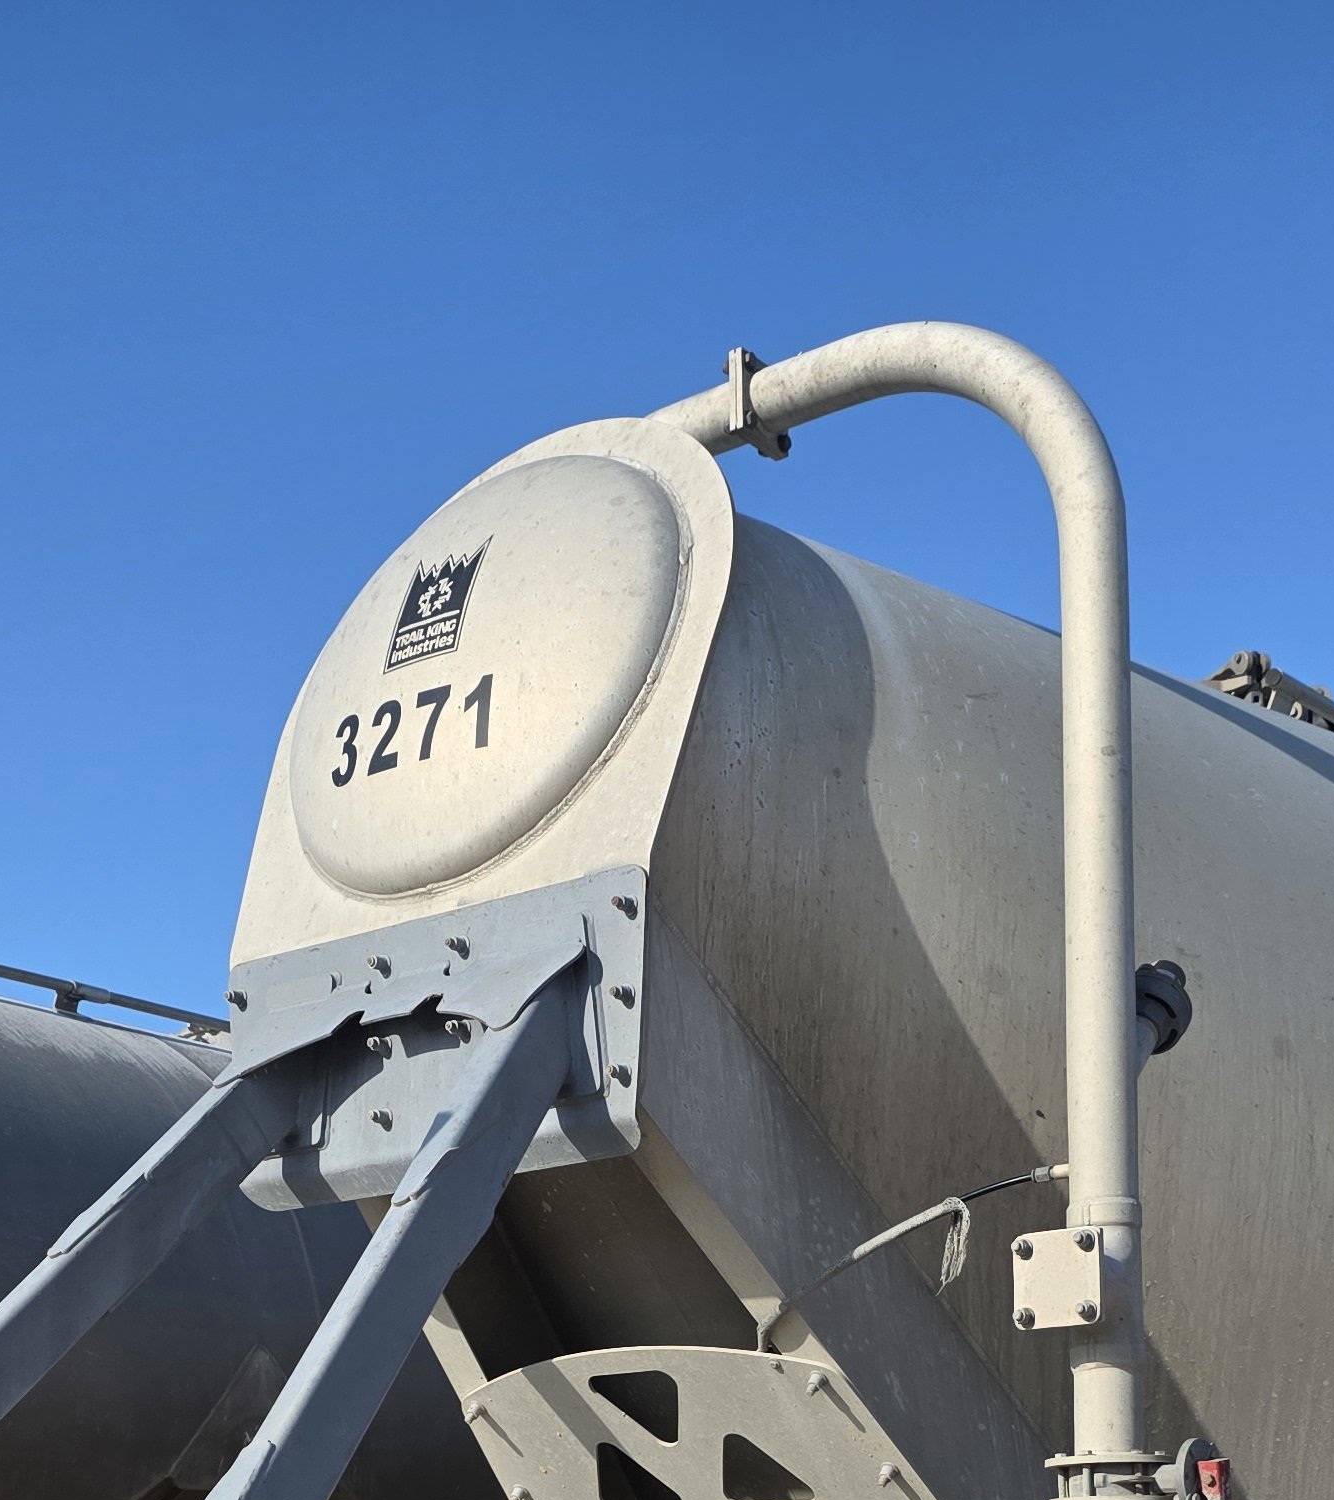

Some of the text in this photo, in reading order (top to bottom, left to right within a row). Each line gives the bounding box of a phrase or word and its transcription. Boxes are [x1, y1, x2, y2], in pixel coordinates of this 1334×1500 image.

[390, 634, 455, 664] industries
[395, 619, 457, 649] TRAIL KING
[331, 673, 494, 788] 3271
